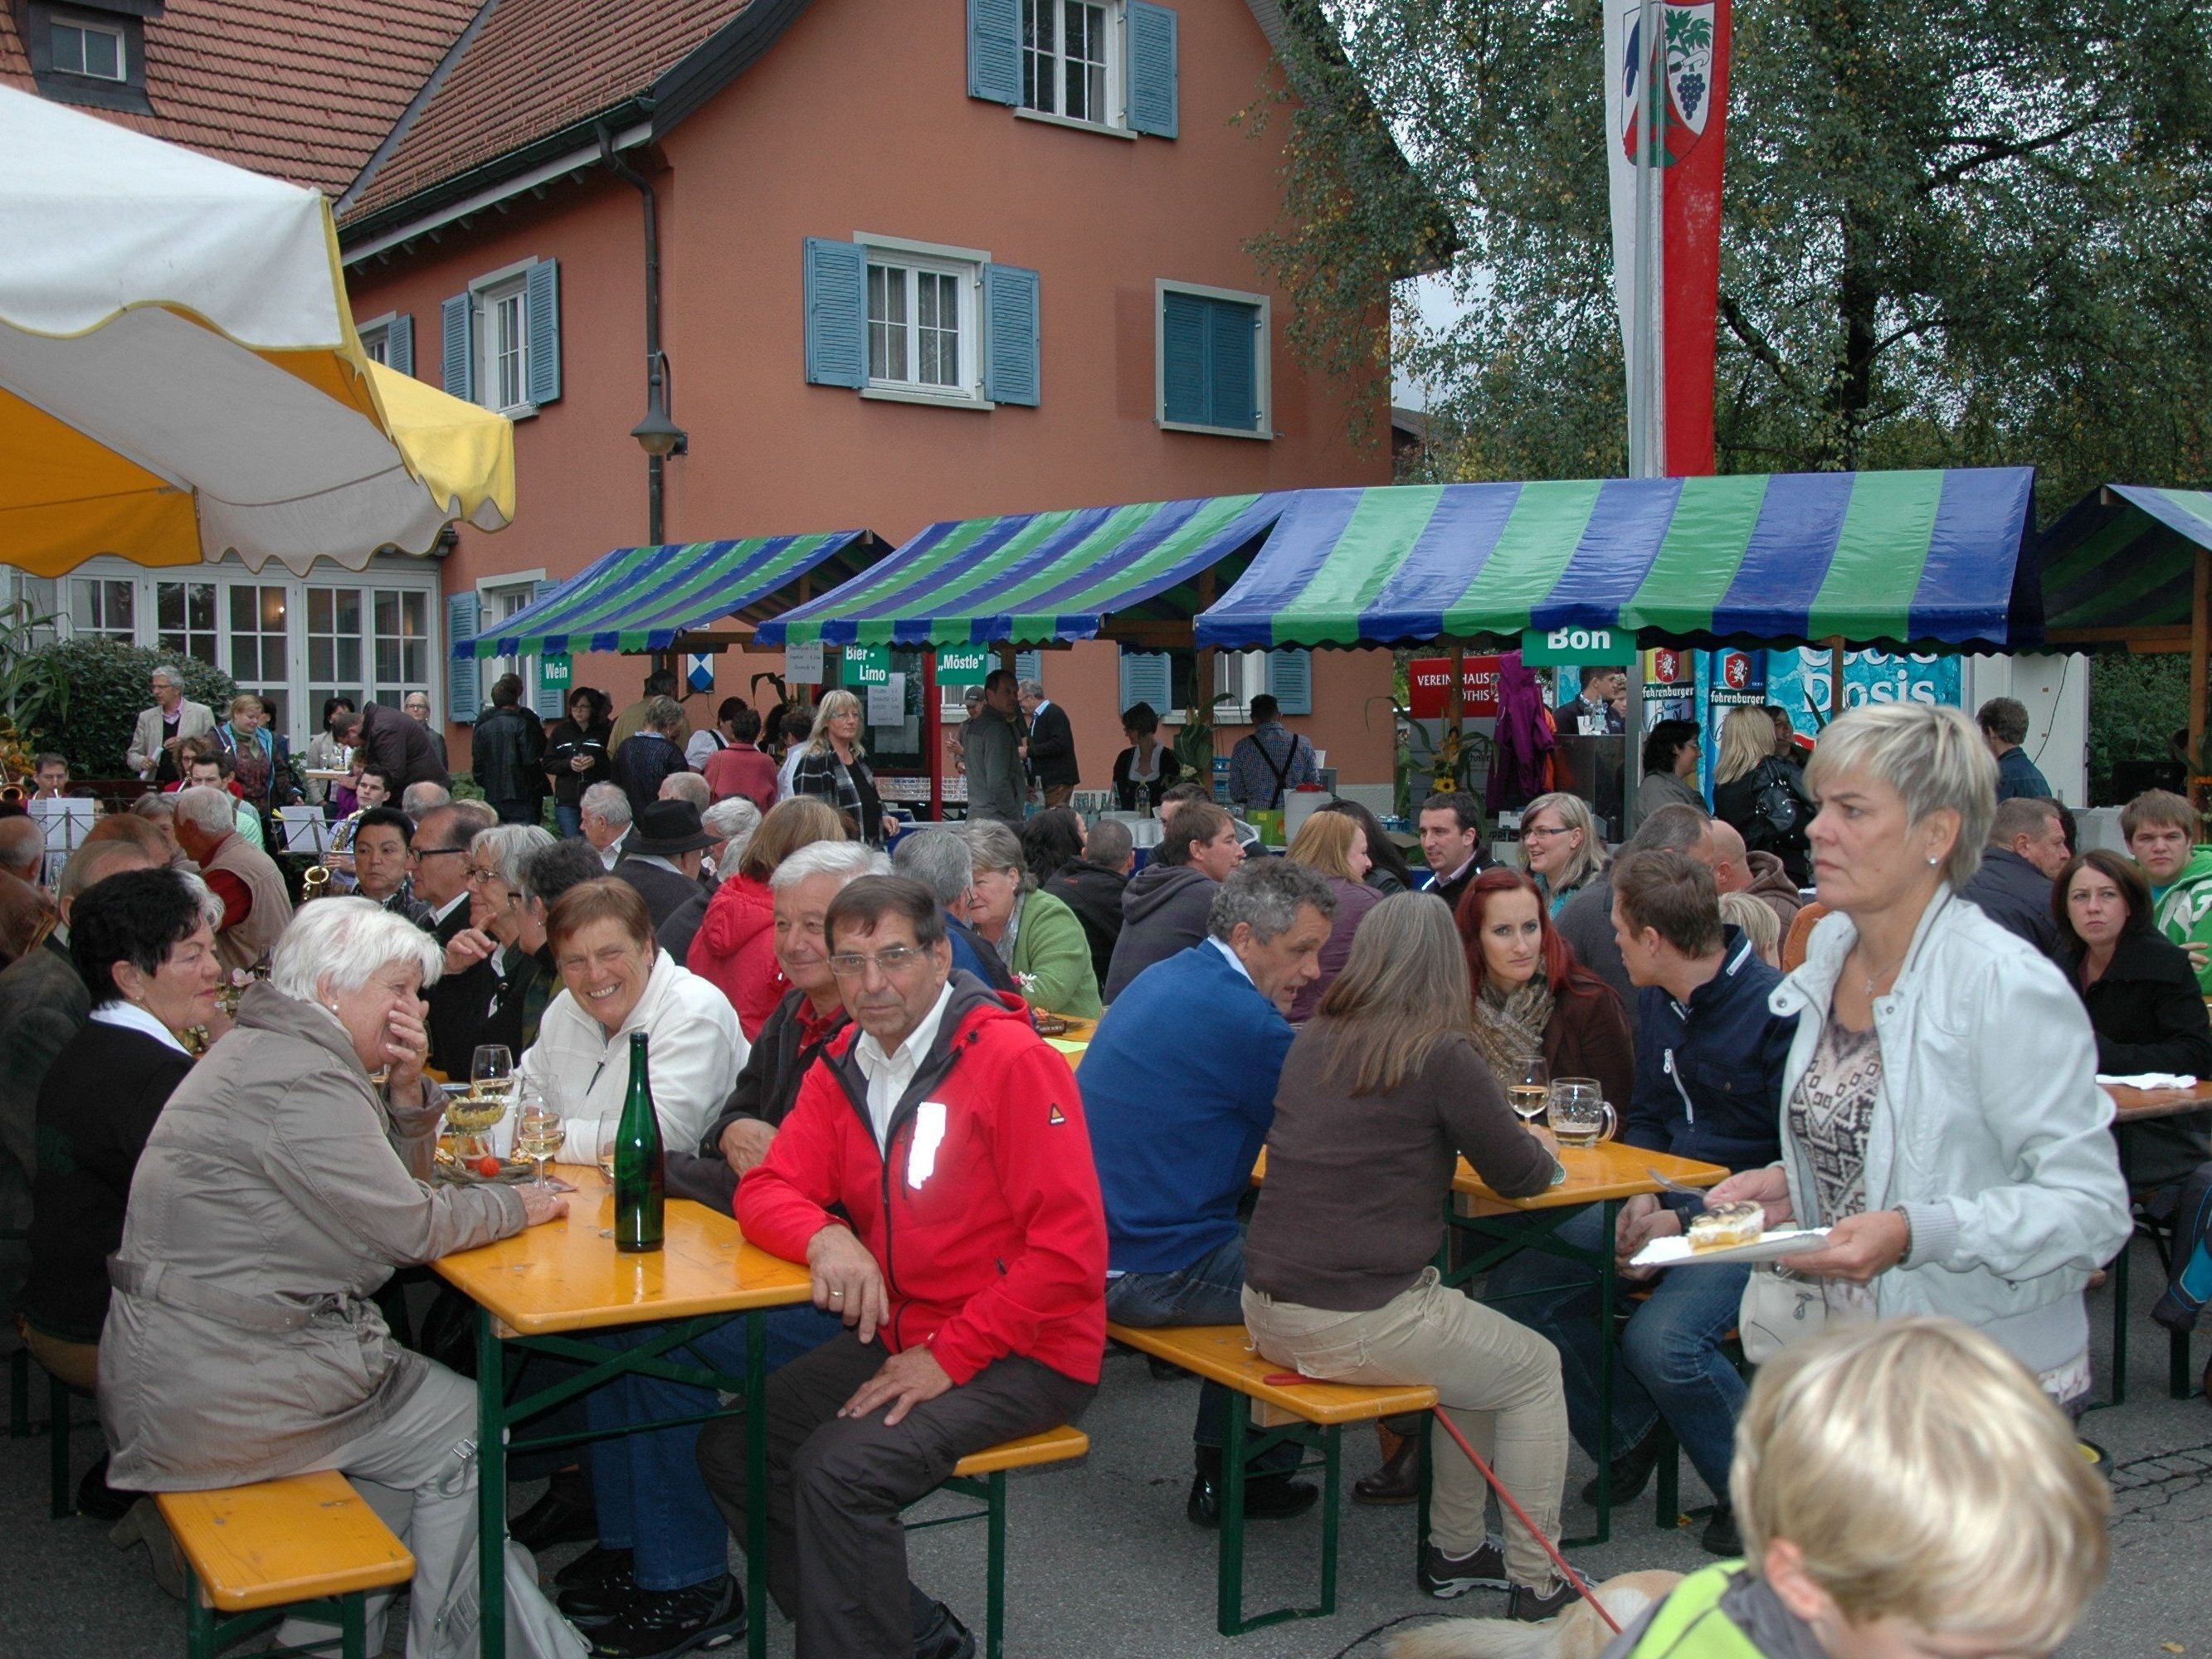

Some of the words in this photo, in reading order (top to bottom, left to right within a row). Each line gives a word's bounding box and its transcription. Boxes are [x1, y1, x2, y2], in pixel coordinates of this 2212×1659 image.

[1547, 627, 1610, 649] Bon
[845, 646, 868, 660] Bier
[545, 662, 568, 679] Wein
[859, 664, 886, 681] Limo
[1802, 669, 1937, 713] Dosis
